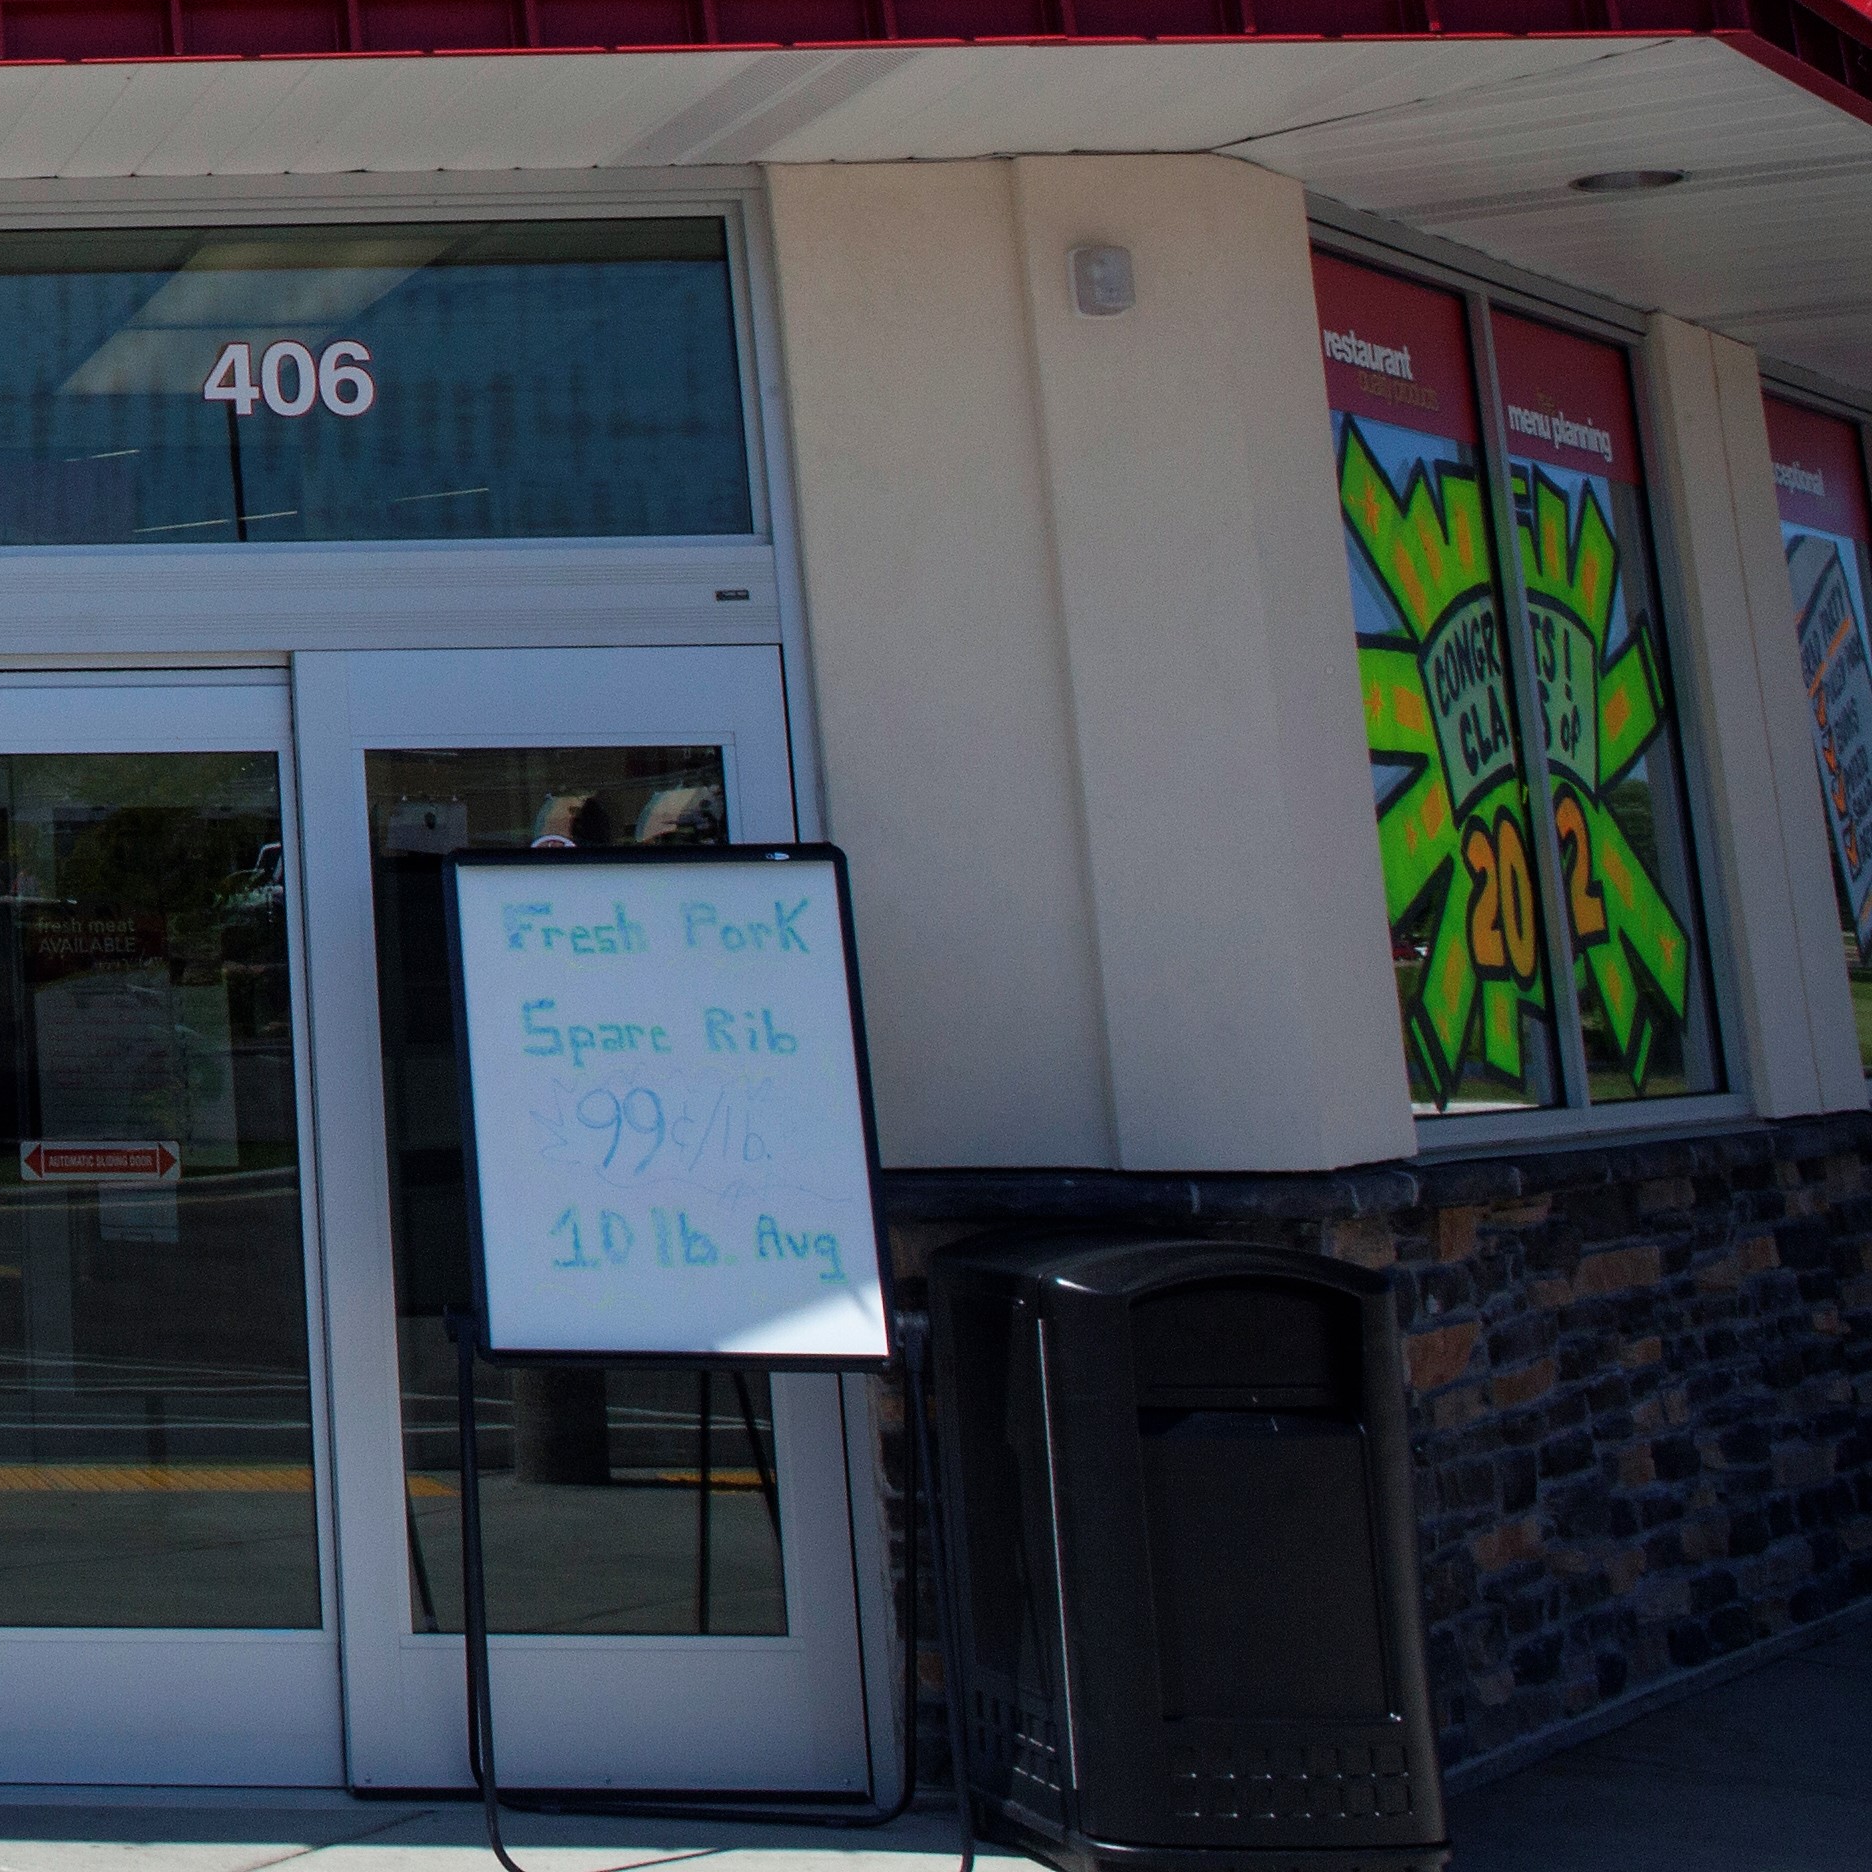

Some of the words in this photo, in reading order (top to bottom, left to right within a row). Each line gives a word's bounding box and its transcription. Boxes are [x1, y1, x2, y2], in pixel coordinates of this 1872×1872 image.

[204, 340, 374, 416] 406
[1323, 329, 1414, 382] restaurant
[1508, 405, 1551, 440] menu
[1552, 411, 1613, 463] planning
[1434, 610, 1572, 717] CONGRTS!
[1459, 681, 1552, 777] CLAS
[1461, 783, 1609, 992] 202
[38, 936, 136, 953] AVAILABLE
[502, 901, 649, 955] Fresh
[520, 998, 672, 1068] Spare
[703, 1007, 798, 1056] Rib
[48, 1155, 94, 1168] AUTOMATIC
[96, 1155, 127, 1167] SLIDING
[129, 1155, 153, 1167] DOOR
